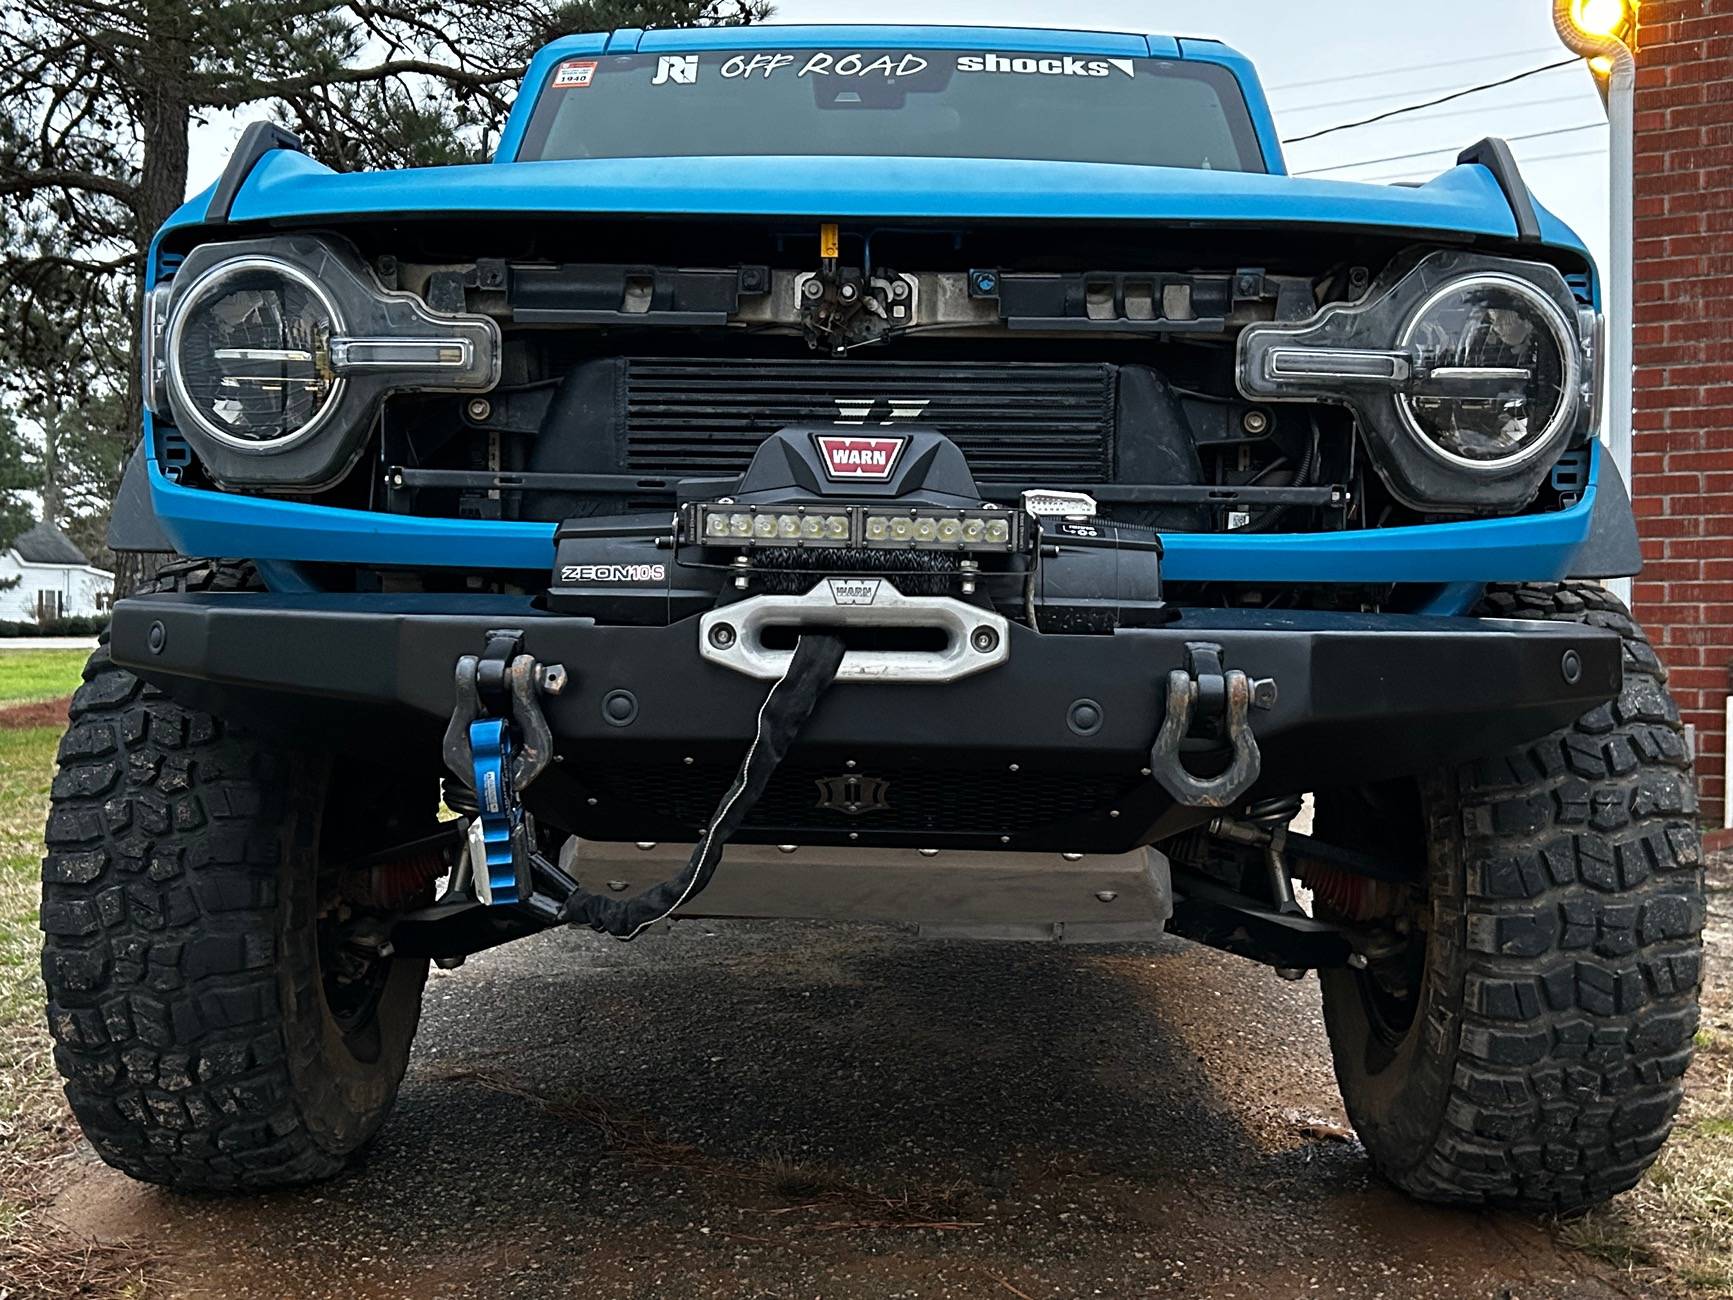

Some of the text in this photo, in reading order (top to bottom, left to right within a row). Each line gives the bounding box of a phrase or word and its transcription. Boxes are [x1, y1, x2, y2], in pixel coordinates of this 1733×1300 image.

[720, 53, 795, 79] OFF
[798, 53, 928, 78] ROAD
[957, 53, 1110, 77] shocks
[832, 449, 886, 465] WARN
[836, 587, 872, 597] WARN
